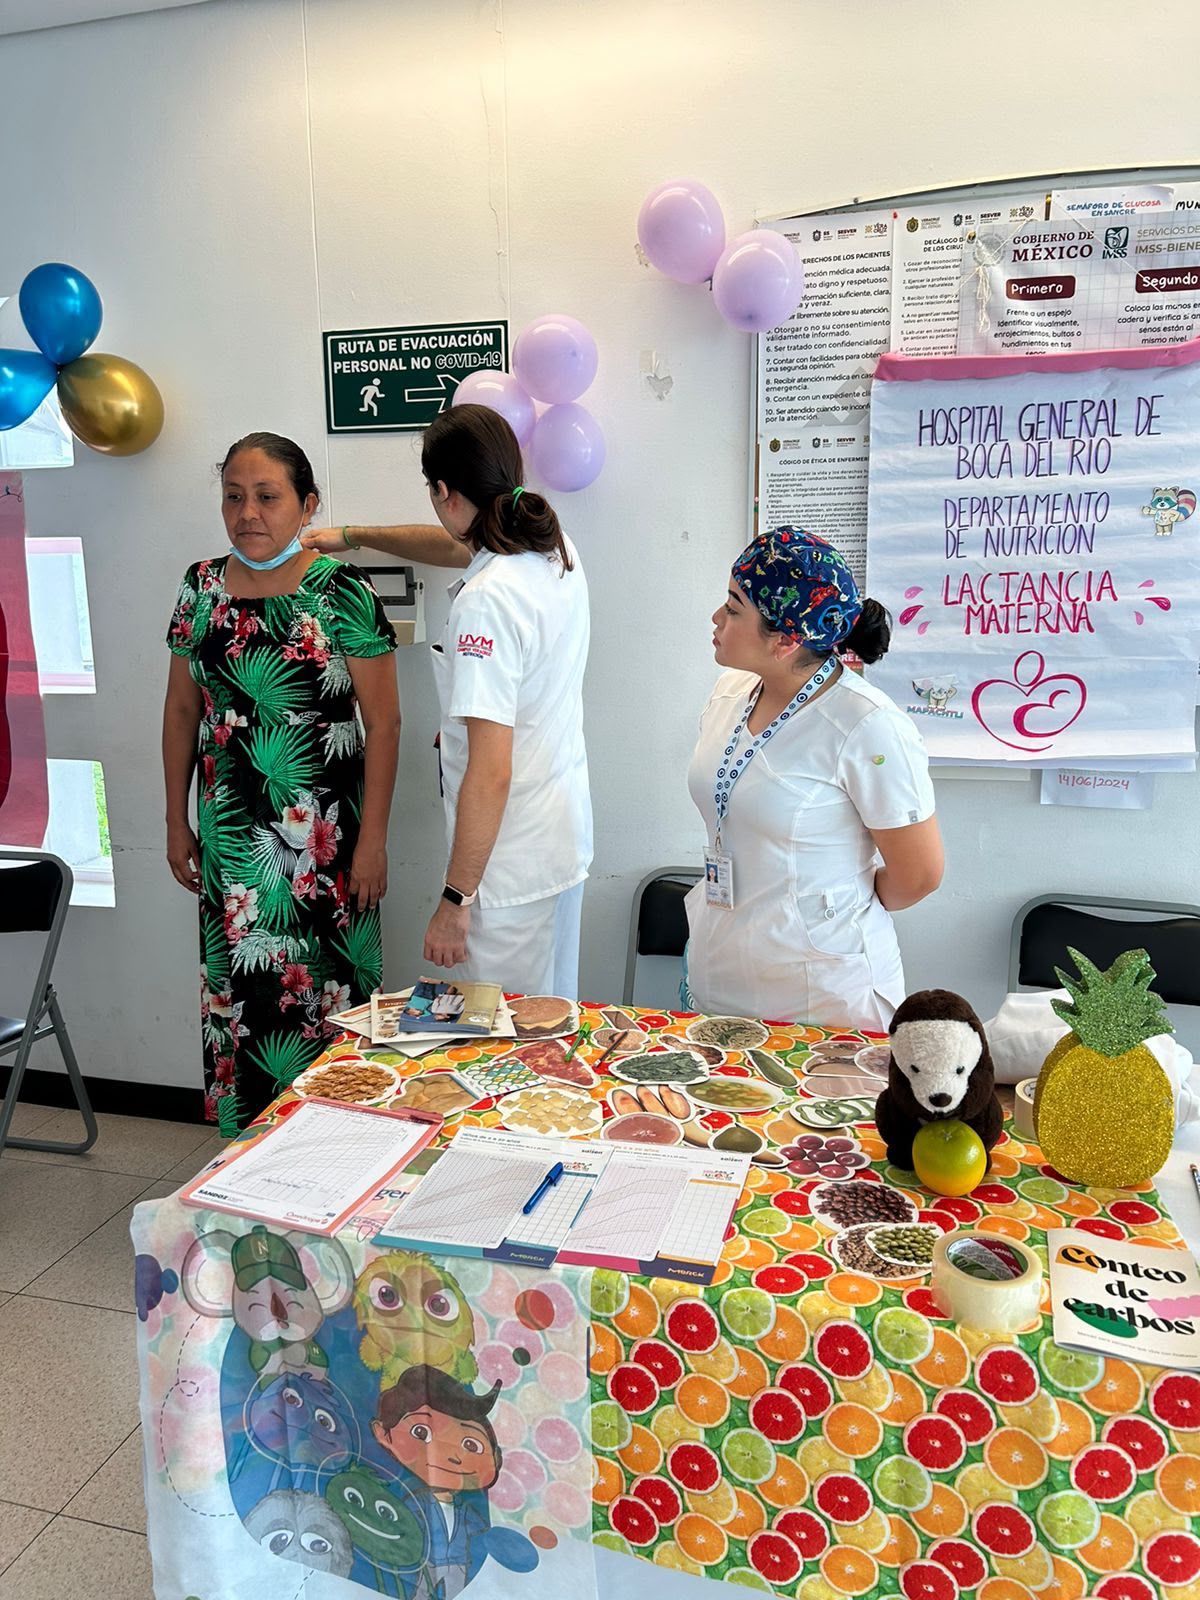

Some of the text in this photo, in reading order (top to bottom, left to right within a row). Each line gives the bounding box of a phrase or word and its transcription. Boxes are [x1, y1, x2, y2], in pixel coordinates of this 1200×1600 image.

[1125, 200, 1161, 208] GLUCOSA
[1013, 231, 1094, 244] GOBIERNO DE
[1137, 226, 1185, 238] SERVICIOS
[924, 237, 957, 245] DECÁLOGO
[856, 251, 890, 259] PACIENTES
[1012, 244, 1093, 262] MÉXICO
[1102, 249, 1127, 259] IMSS
[805, 265, 891, 278] ención médica adecuada.
[819, 280, 839, 289] digno
[847, 277, 888, 286] respetuoso.
[1143, 272, 1198, 289] Segundo
[802, 288, 891, 301] formación suficiente, clara,
[1012, 283, 1063, 294] Primero
[797, 310, 831, 319] libremente
[832, 309, 850, 317] sobre
[1047, 309, 1072, 317] espejo
[774, 326, 802, 334] Otorgar
[832, 320, 890, 329] consentimiento
[766, 332, 810, 341] válidamente
[994, 330, 1050, 338] enrojecimientos,
[338, 331, 493, 354] RUTA DE EVACUACIÓN
[787, 343, 812, 351] tratado
[828, 338, 889, 348] confidencialidad.
[334, 352, 502, 373] PERSONAL NO COVID-19
[810, 354, 844, 362] facilidades
[780, 364, 808, 372] segunda
[774, 377, 795, 385] Recibir
[796, 375, 825, 383] atención
[826, 373, 850, 381] médica
[766, 384, 809, 392] emergencia.
[822, 391, 860, 400] expediente
[787, 406, 814, 414] atendido
[765, 416, 778, 424] por
[787, 414, 819, 422] atención.
[918, 395, 1164, 447] HOSPITAL GENERAL DE
[956, 437, 1112, 480] BOCA DEL RIO
[944, 491, 1111, 529] DEPARTAMENTO
[944, 524, 1096, 560] DE NUTRICION
[942, 570, 1118, 606] LACTANCIA
[964, 601, 1095, 635] MATERNA
[459, 634, 493, 649] UVM
[1058, 774, 1130, 790] 14/06/2024
[198, 1189, 228, 1200] SANDOZ
[257, 1241, 268, 1254] N
[1061, 1247, 1187, 1284] Conteo
[1105, 1280, 1148, 1303] de
[1063, 1298, 1195, 1335] carbos
